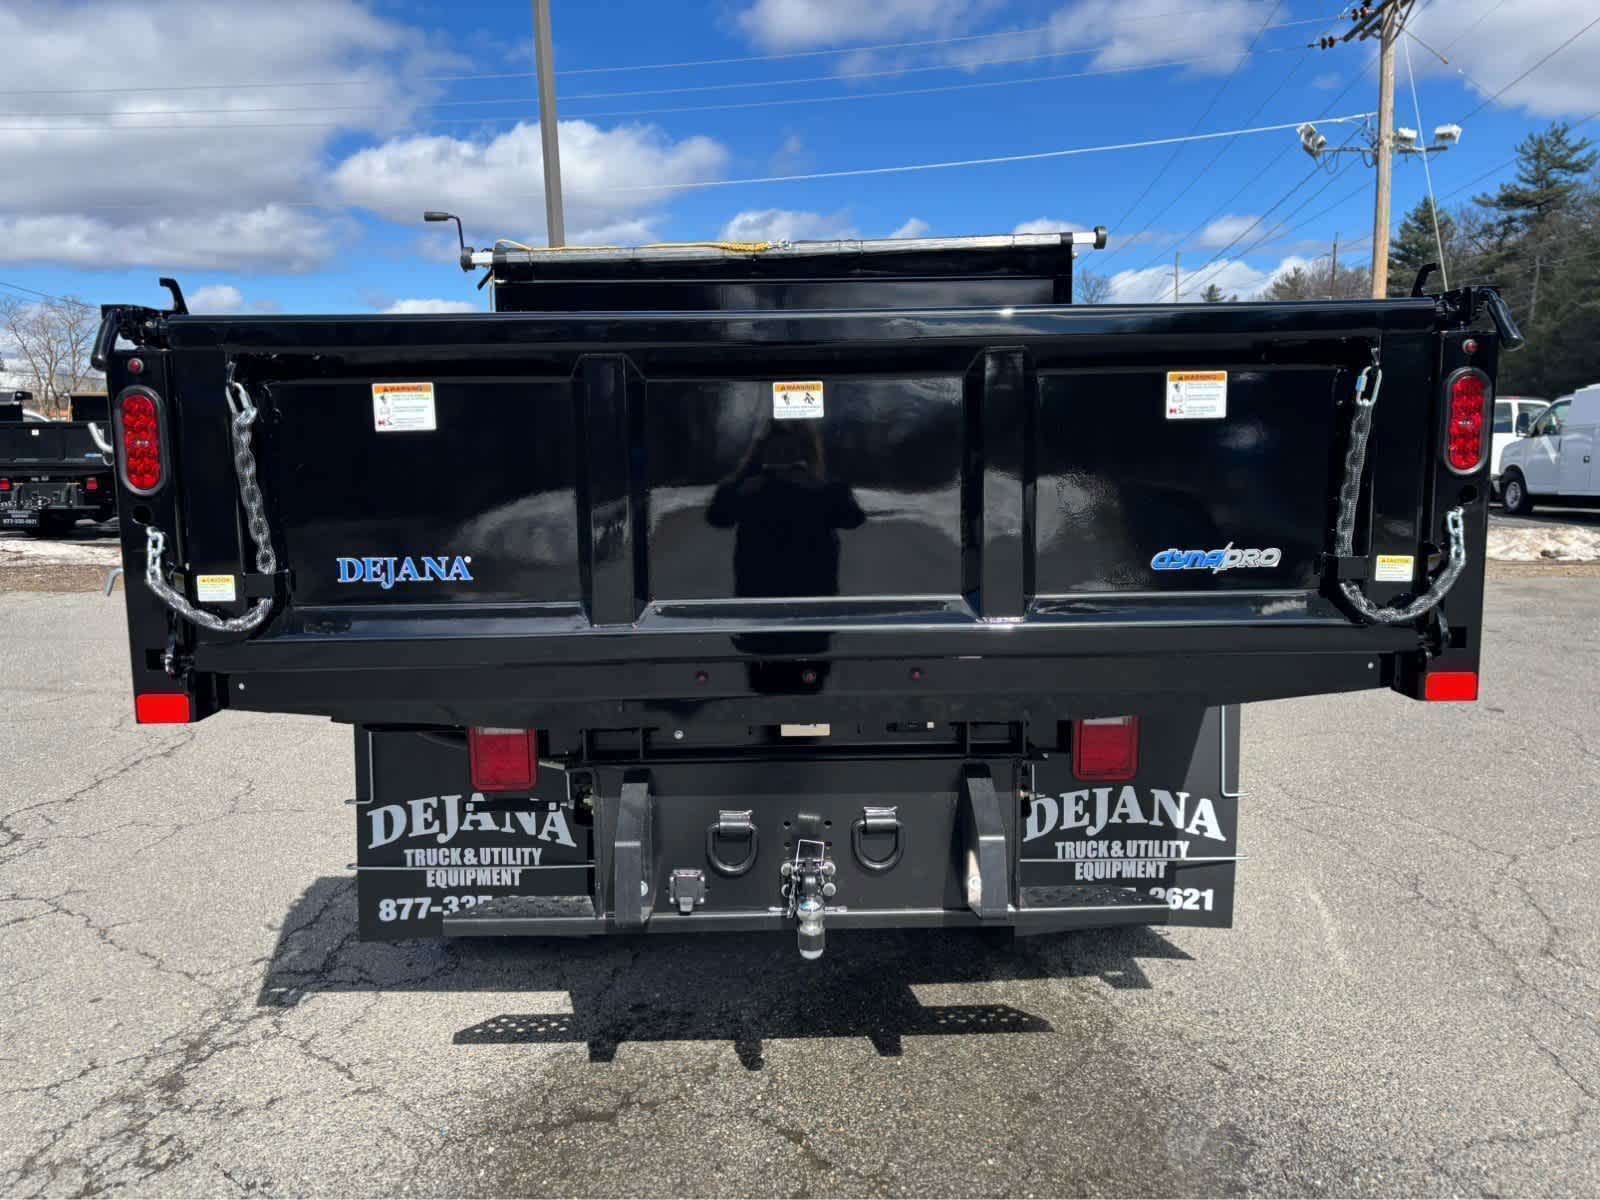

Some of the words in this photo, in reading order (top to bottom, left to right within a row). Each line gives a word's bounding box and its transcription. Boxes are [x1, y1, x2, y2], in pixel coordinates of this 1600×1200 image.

[336, 556, 474, 590] DEJANA
[366, 792, 577, 849] DEJANA
[1022, 785, 1226, 842] DEJANA
[426, 867, 522, 889] EQUIPMENT
[1074, 860, 1168, 881] EQUIPMENT
[378, 895, 493, 921] 877-3
